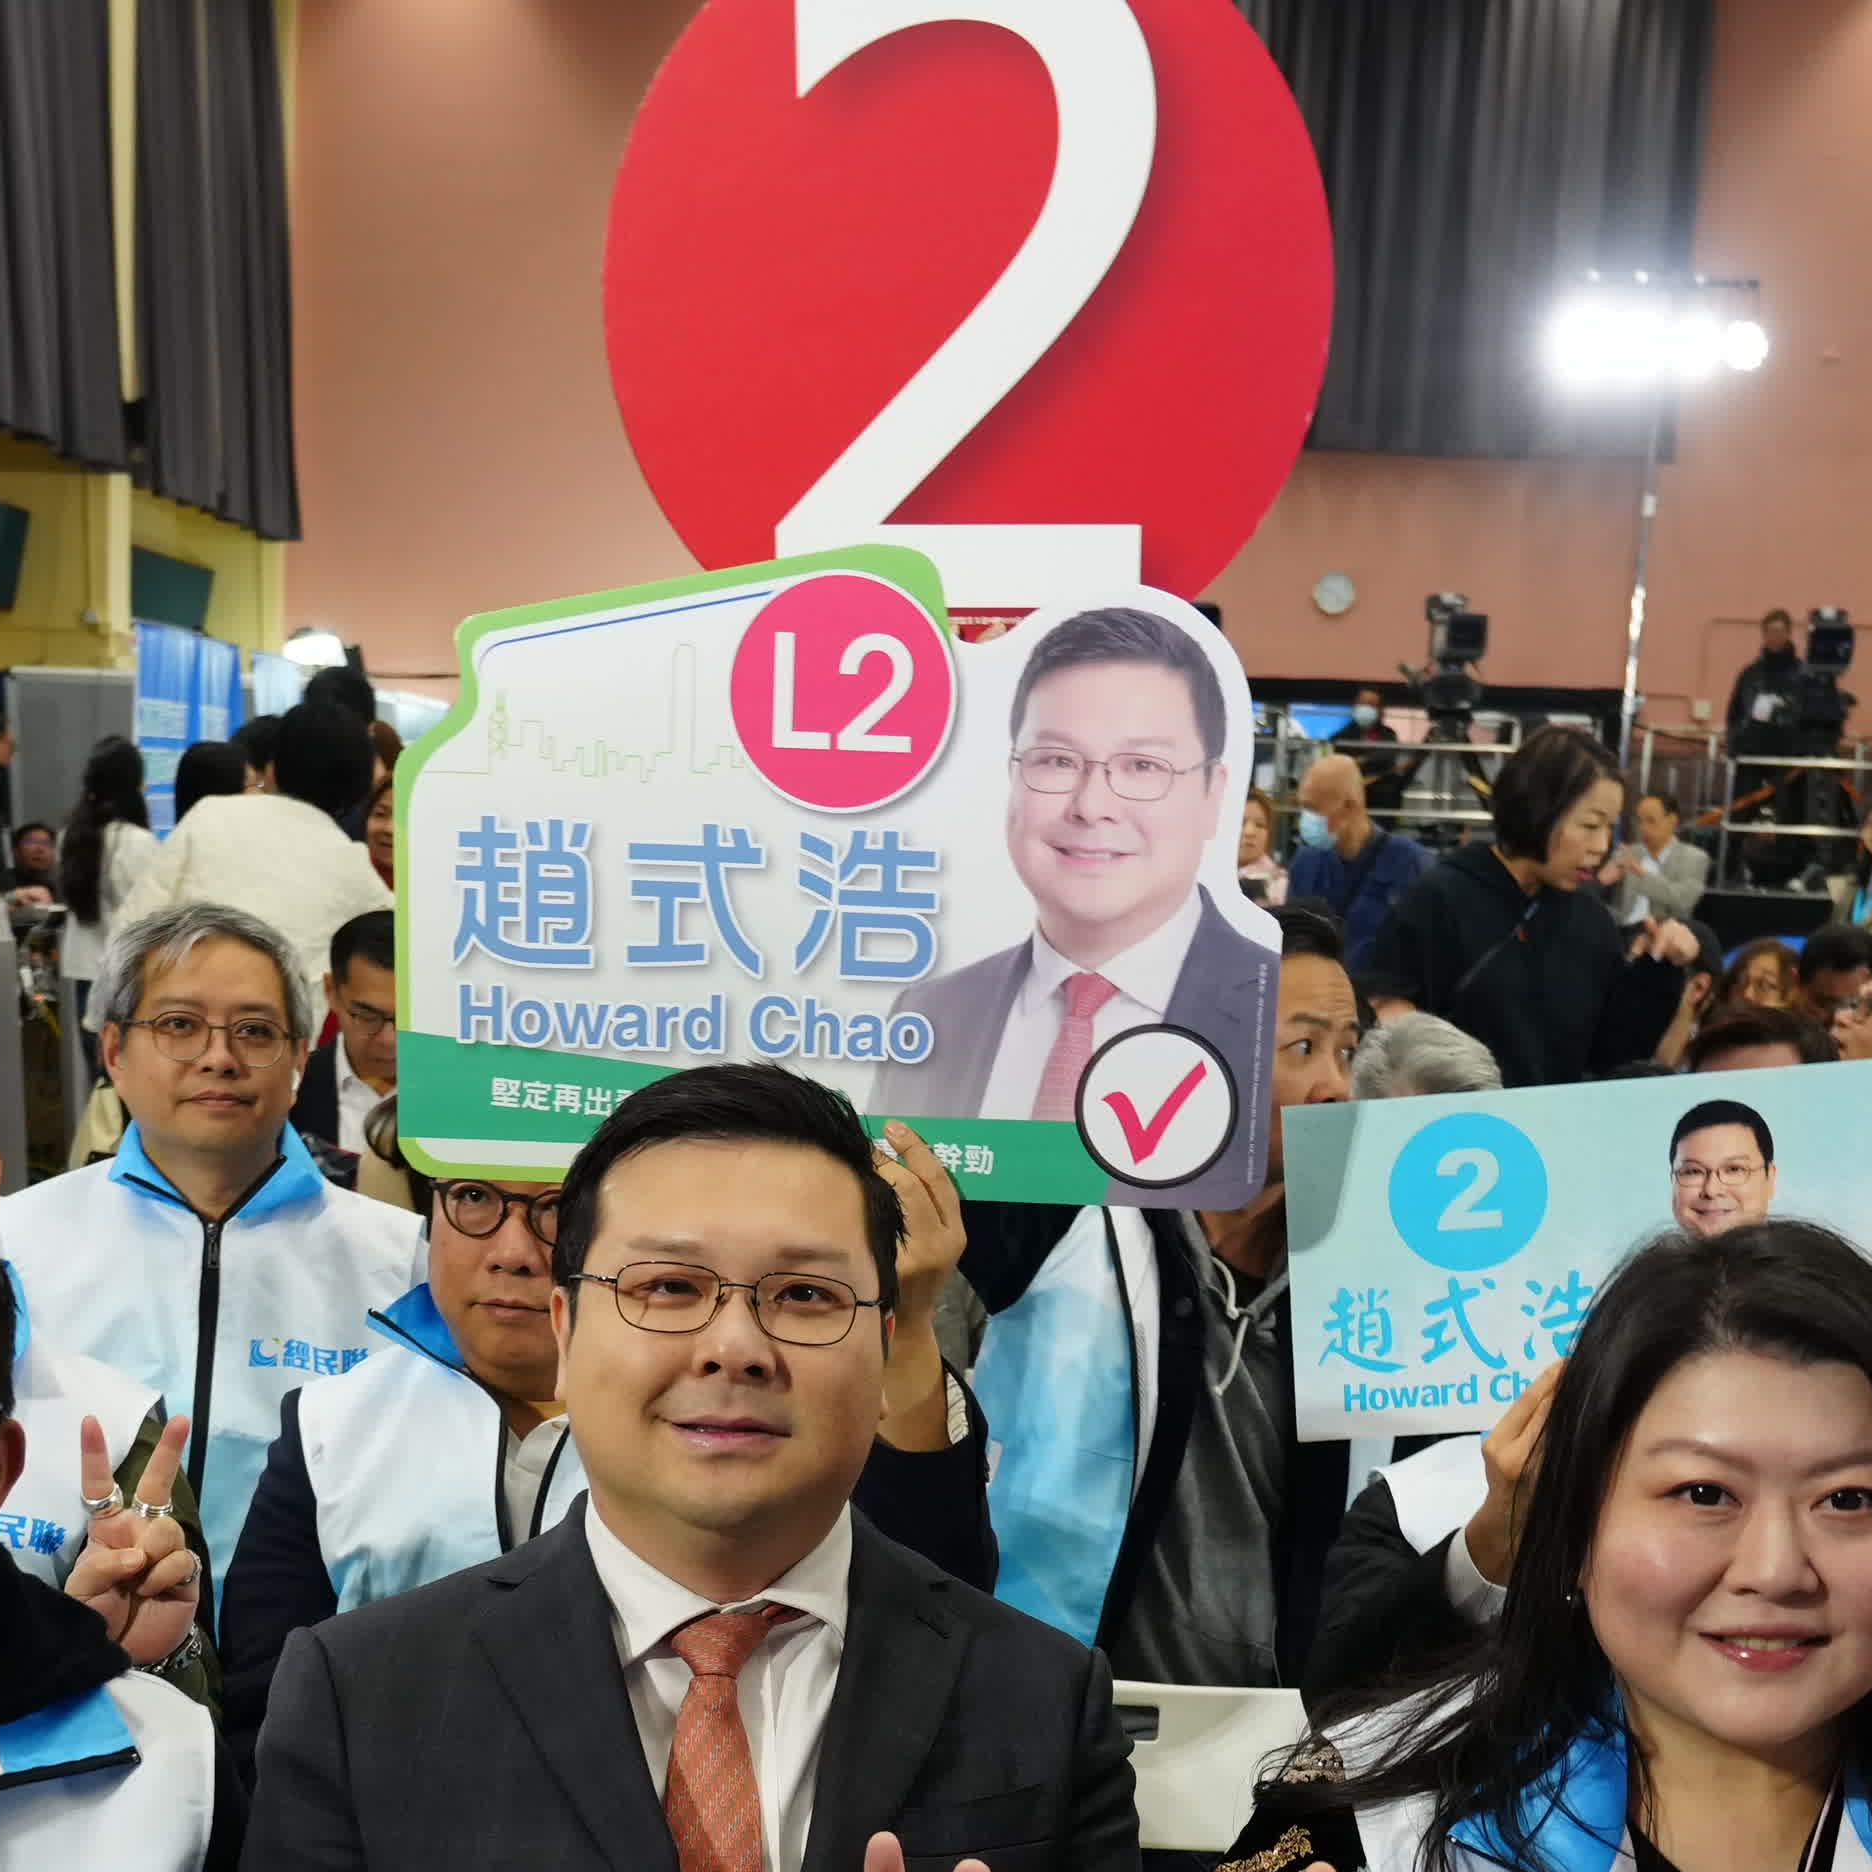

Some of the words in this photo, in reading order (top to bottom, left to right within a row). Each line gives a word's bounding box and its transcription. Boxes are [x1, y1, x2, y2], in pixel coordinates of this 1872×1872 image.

[775, 0, 1157, 607] 2
[771, 631, 913, 754] L2
[452, 815, 940, 984] 趙式浩
[457, 984, 724, 1053] Howard
[748, 994, 932, 1062] Chao
[1435, 1147, 1503, 1231] 2
[1319, 1270, 1591, 1373] 趙式浩
[1343, 1376, 1478, 1412] Howard
[1489, 1371, 1532, 1404] Ch
